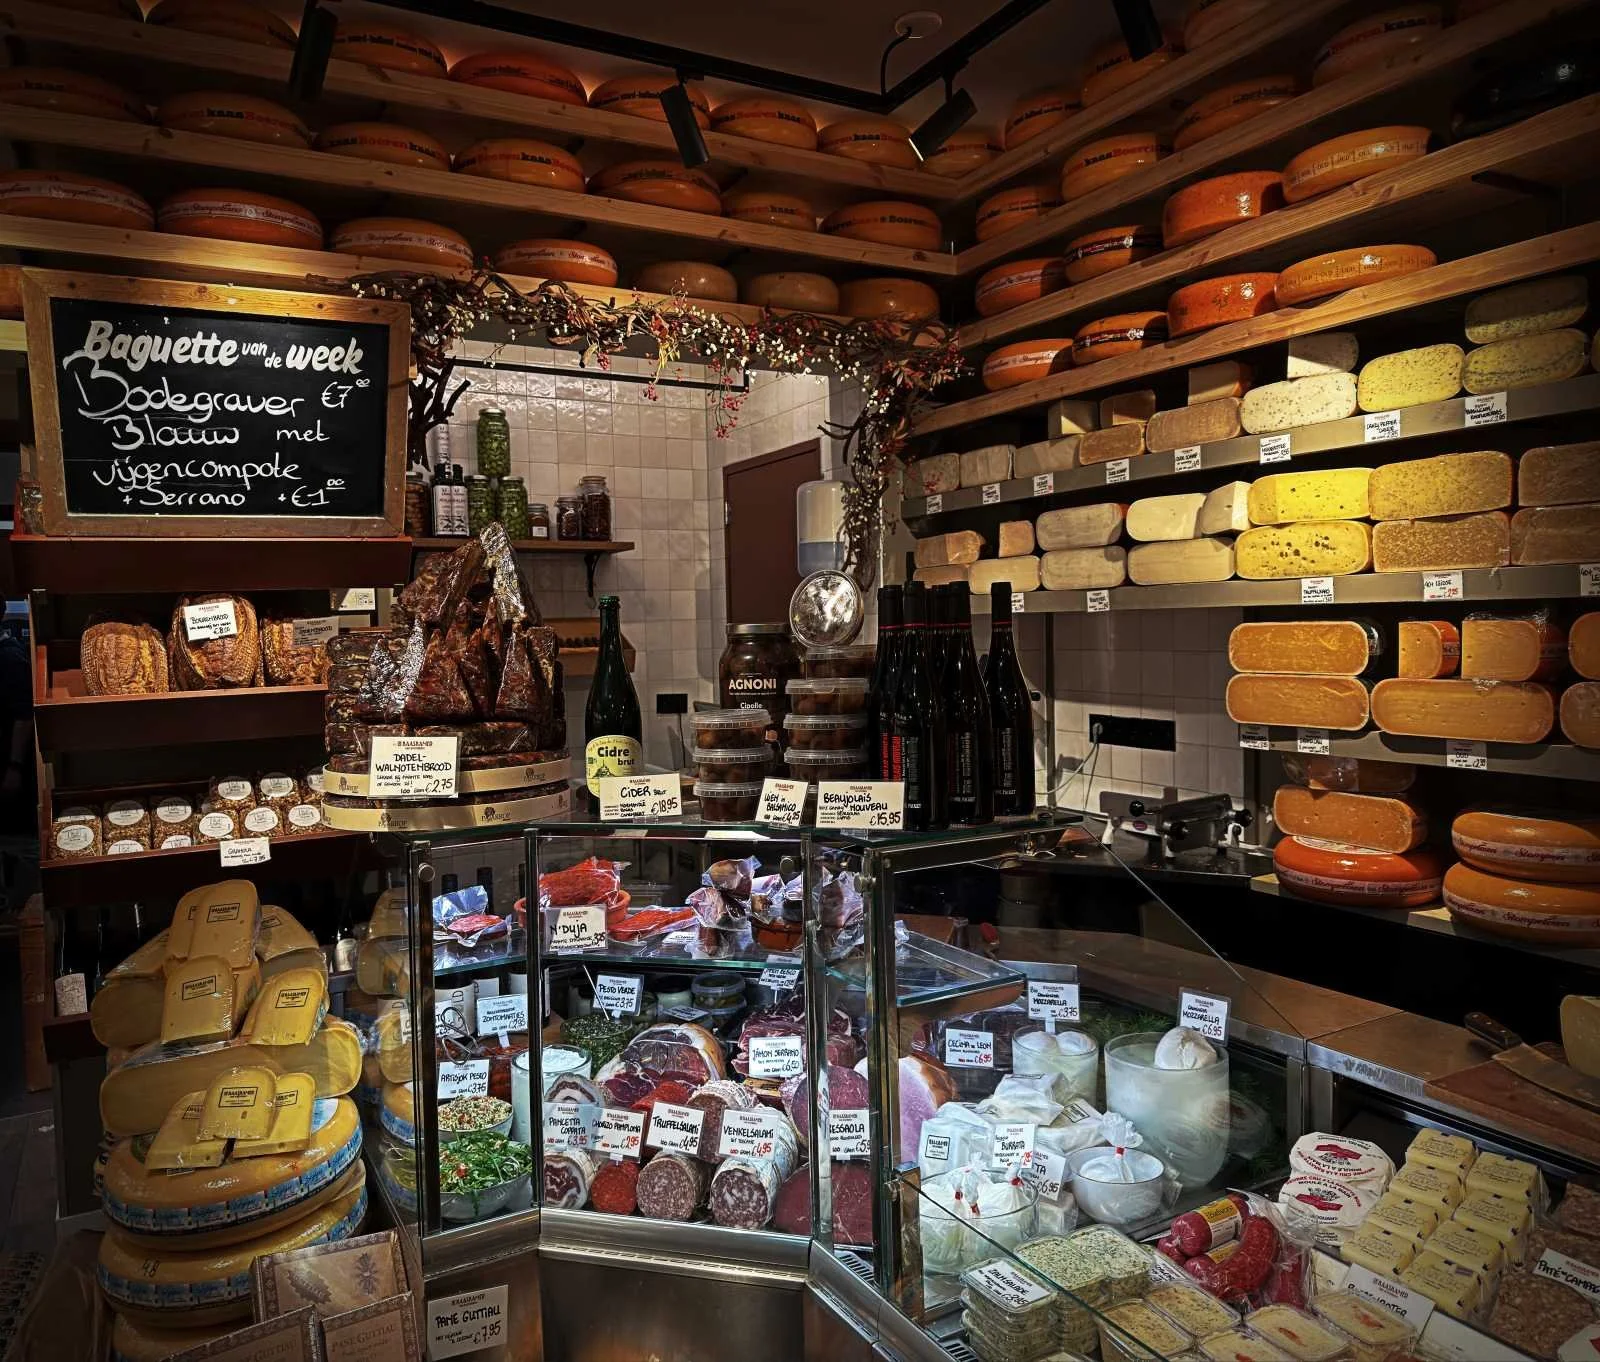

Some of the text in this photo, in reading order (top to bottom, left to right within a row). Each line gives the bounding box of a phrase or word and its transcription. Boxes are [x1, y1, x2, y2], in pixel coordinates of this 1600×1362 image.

[85, 320, 365, 375] Baguette van de week
[104, 414, 330, 451] Blauw met
[139, 483, 246, 507] Serrano
[729, 678, 777, 689] AGNONI
[598, 746, 630, 757] Cidre
[393, 753, 427, 762] DADEL-
[617, 758, 635, 766] brut
[375, 762, 452, 772] WALNOTENBROOD
[425, 779, 454, 793] €2.75
[620, 785, 651, 798] CiDER
[651, 797, 678, 815] €18.95
[850, 802, 888, 811] NOUVEAU
[869, 811, 902, 826] €15.95
[598, 983, 636, 994] PESTO VERDE
[1182, 1010, 1220, 1025] MOZZARELLA
[469, 1071, 487, 1081] PESTO
[548, 1117, 581, 1126] PANCETTA
[613, 1121, 641, 1133] PAMPLONA
[560, 1126, 586, 1134] COPPATA
[435, 1312, 460, 1328] PANE
